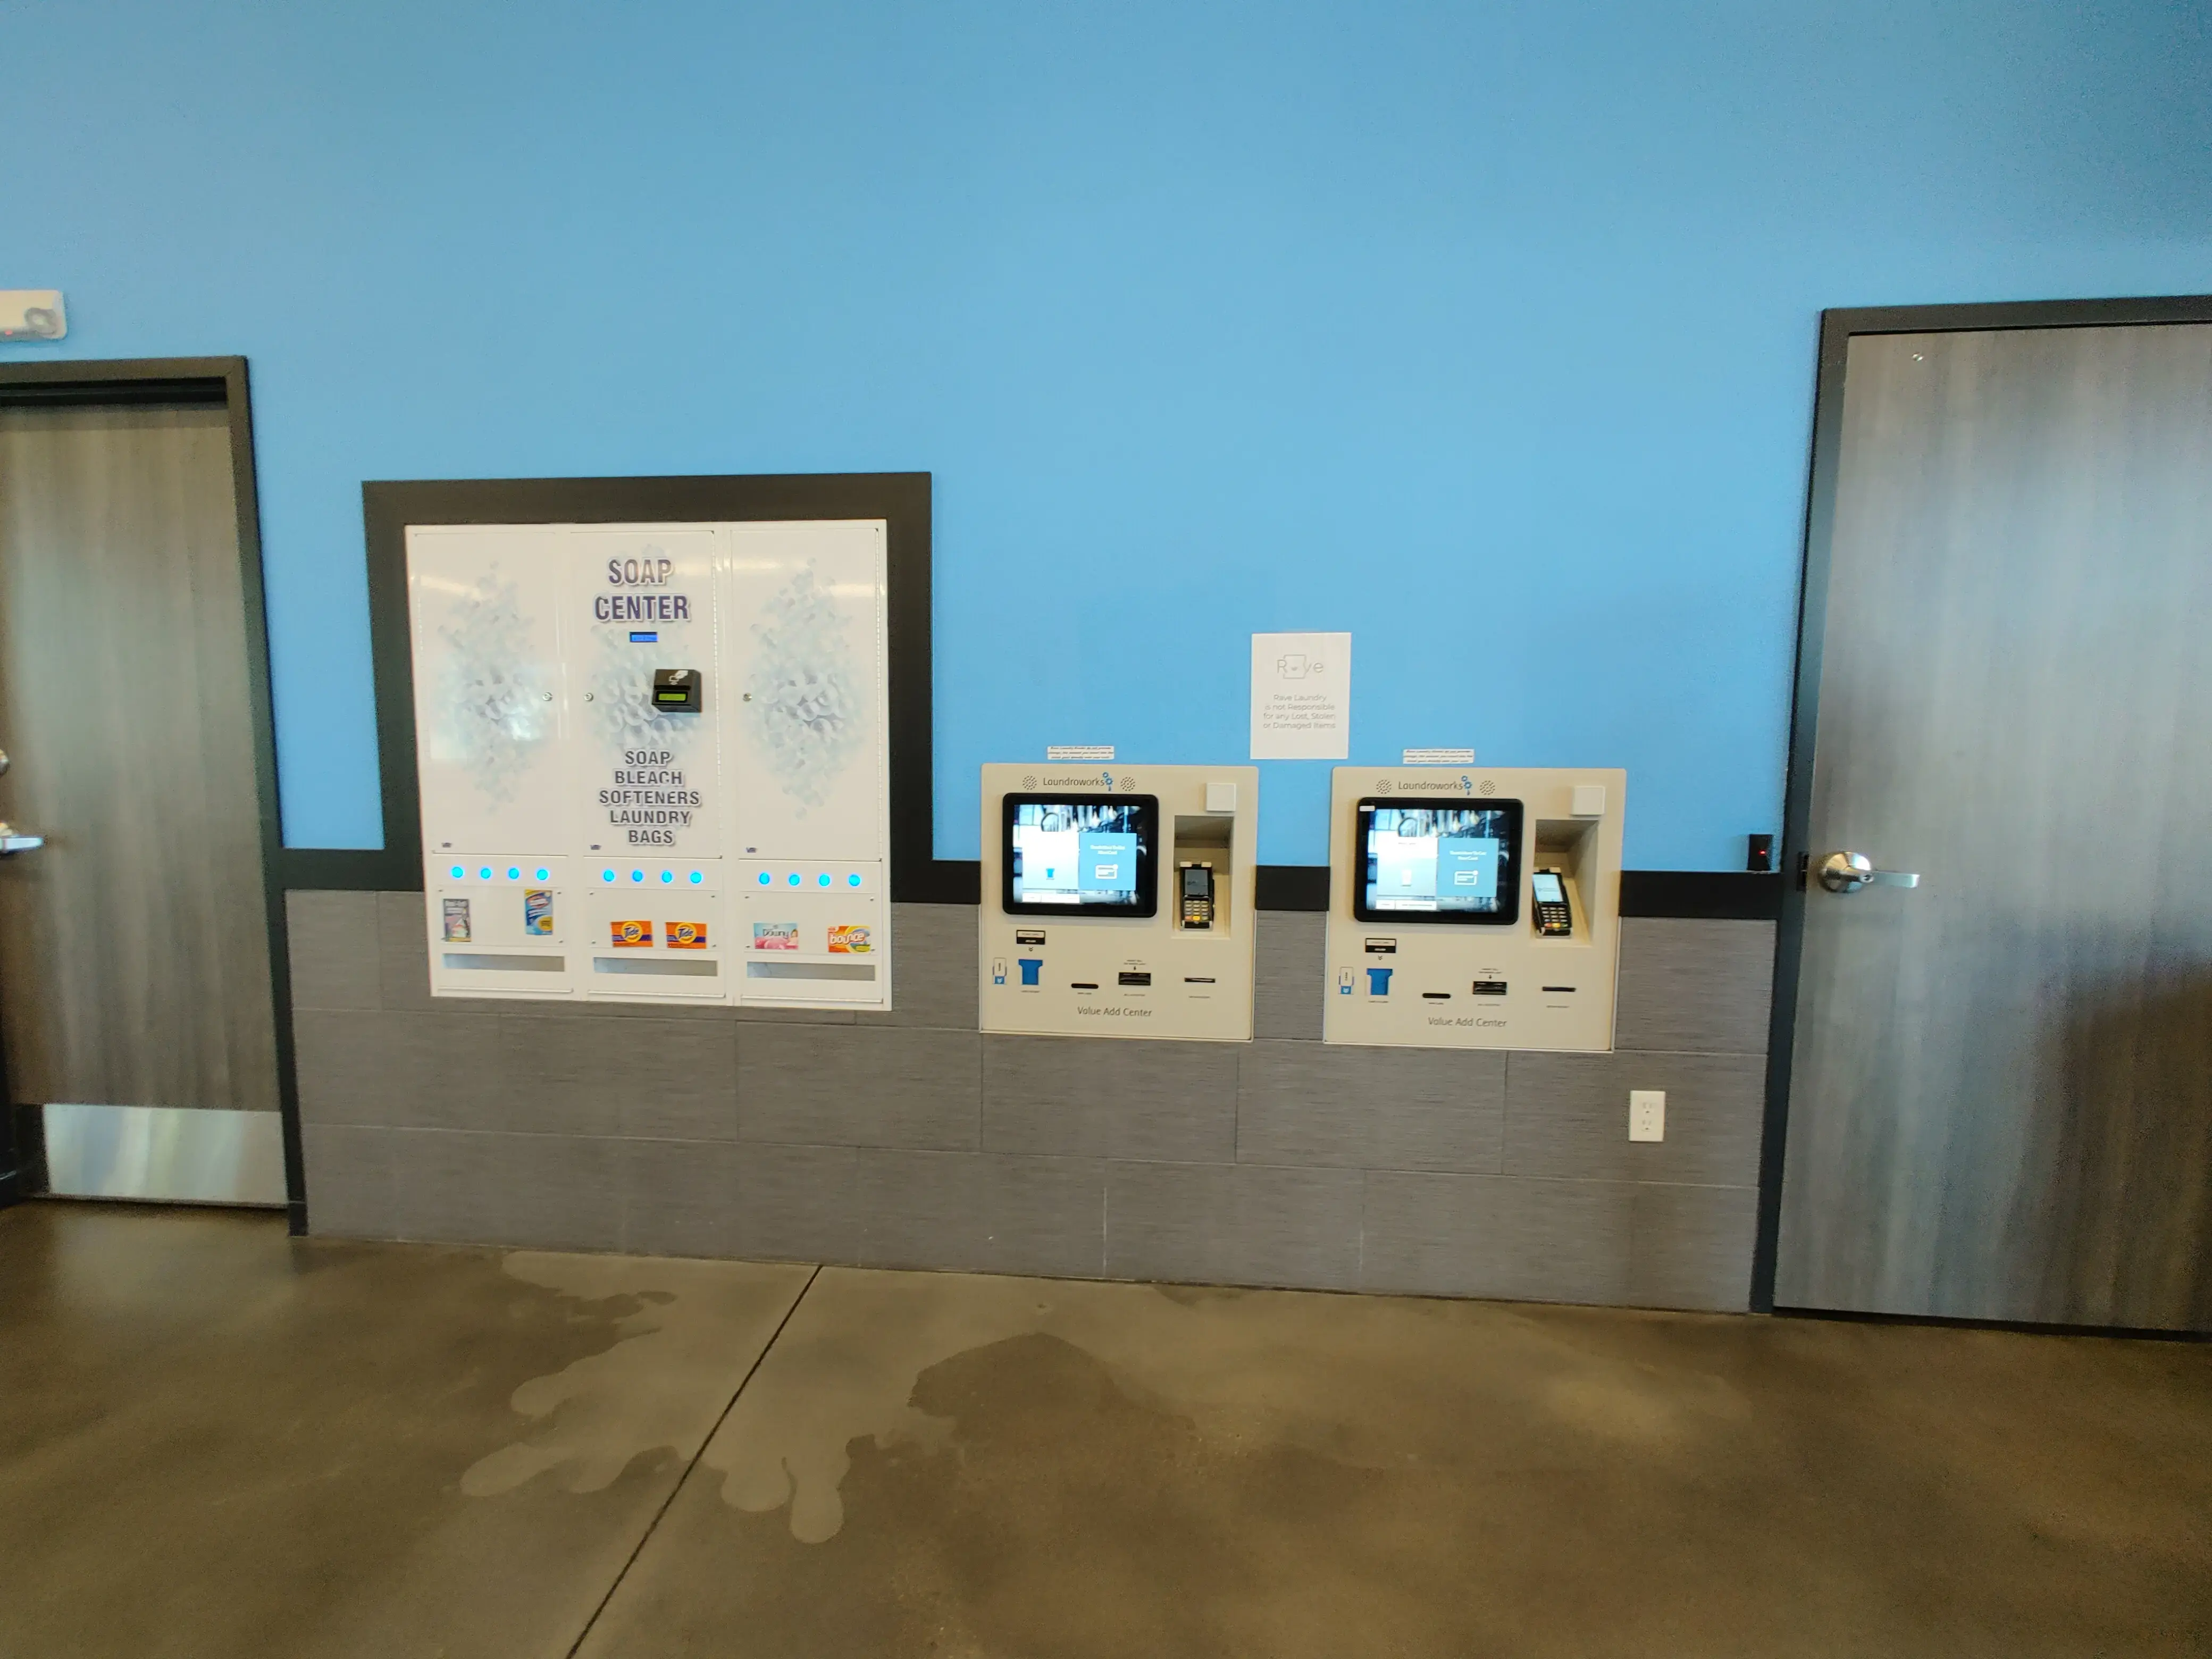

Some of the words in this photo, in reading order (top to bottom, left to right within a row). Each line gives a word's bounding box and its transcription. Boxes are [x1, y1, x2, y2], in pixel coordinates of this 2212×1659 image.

[608, 559, 672, 584] SOAP
[594, 595, 689, 620] CENTER
[1294, 693, 1327, 702] Laundry
[1273, 722, 1312, 730] Damaged
[624, 750, 671, 765] SOAP
[615, 770, 683, 785] BLEACH
[1043, 777, 1105, 786] Laundroworks
[1398, 781, 1463, 790] Laundroworks
[599, 790, 700, 805] SOFTENERS
[610, 810, 691, 824] LAUNDRY
[628, 830, 673, 843] BAGS
[624, 926, 640, 939] Tide
[677, 928, 694, 939] Tide
[1077, 1006, 1101, 1015] Value
[1103, 1007, 1121, 1016] Add
[1123, 1008, 1152, 1017] Center
[1428, 1017, 1453, 1025] Value
[1455, 1018, 1473, 1026] Add
[1476, 1018, 1507, 1027] Center
